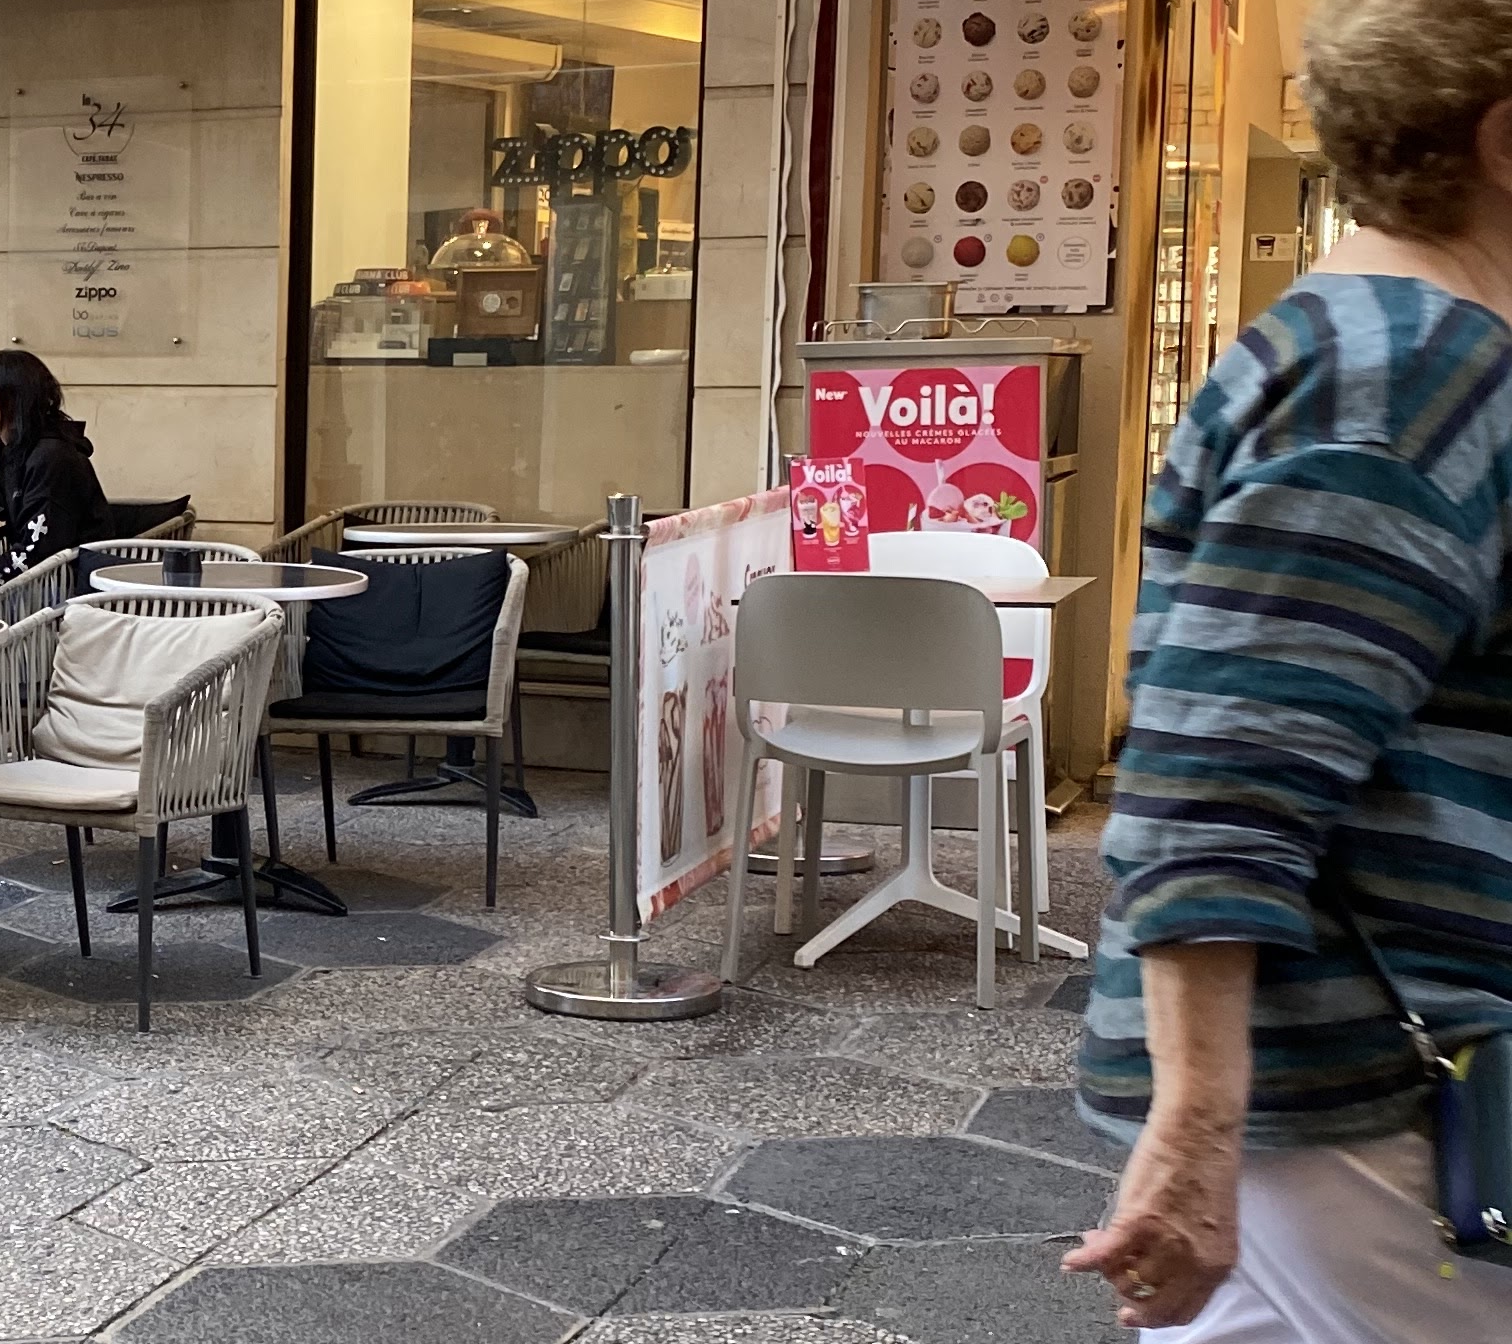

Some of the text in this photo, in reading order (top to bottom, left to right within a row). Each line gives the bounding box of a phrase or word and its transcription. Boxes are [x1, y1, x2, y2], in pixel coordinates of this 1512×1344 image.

[74, 286, 117, 302] zippo
[815, 388, 848, 401] New
[858, 383, 995, 427] Voilà!
[855, 431, 912, 439] NOUVELLES
[911, 437, 962, 445] MACARON
[802, 463, 853, 484] Voilà!
